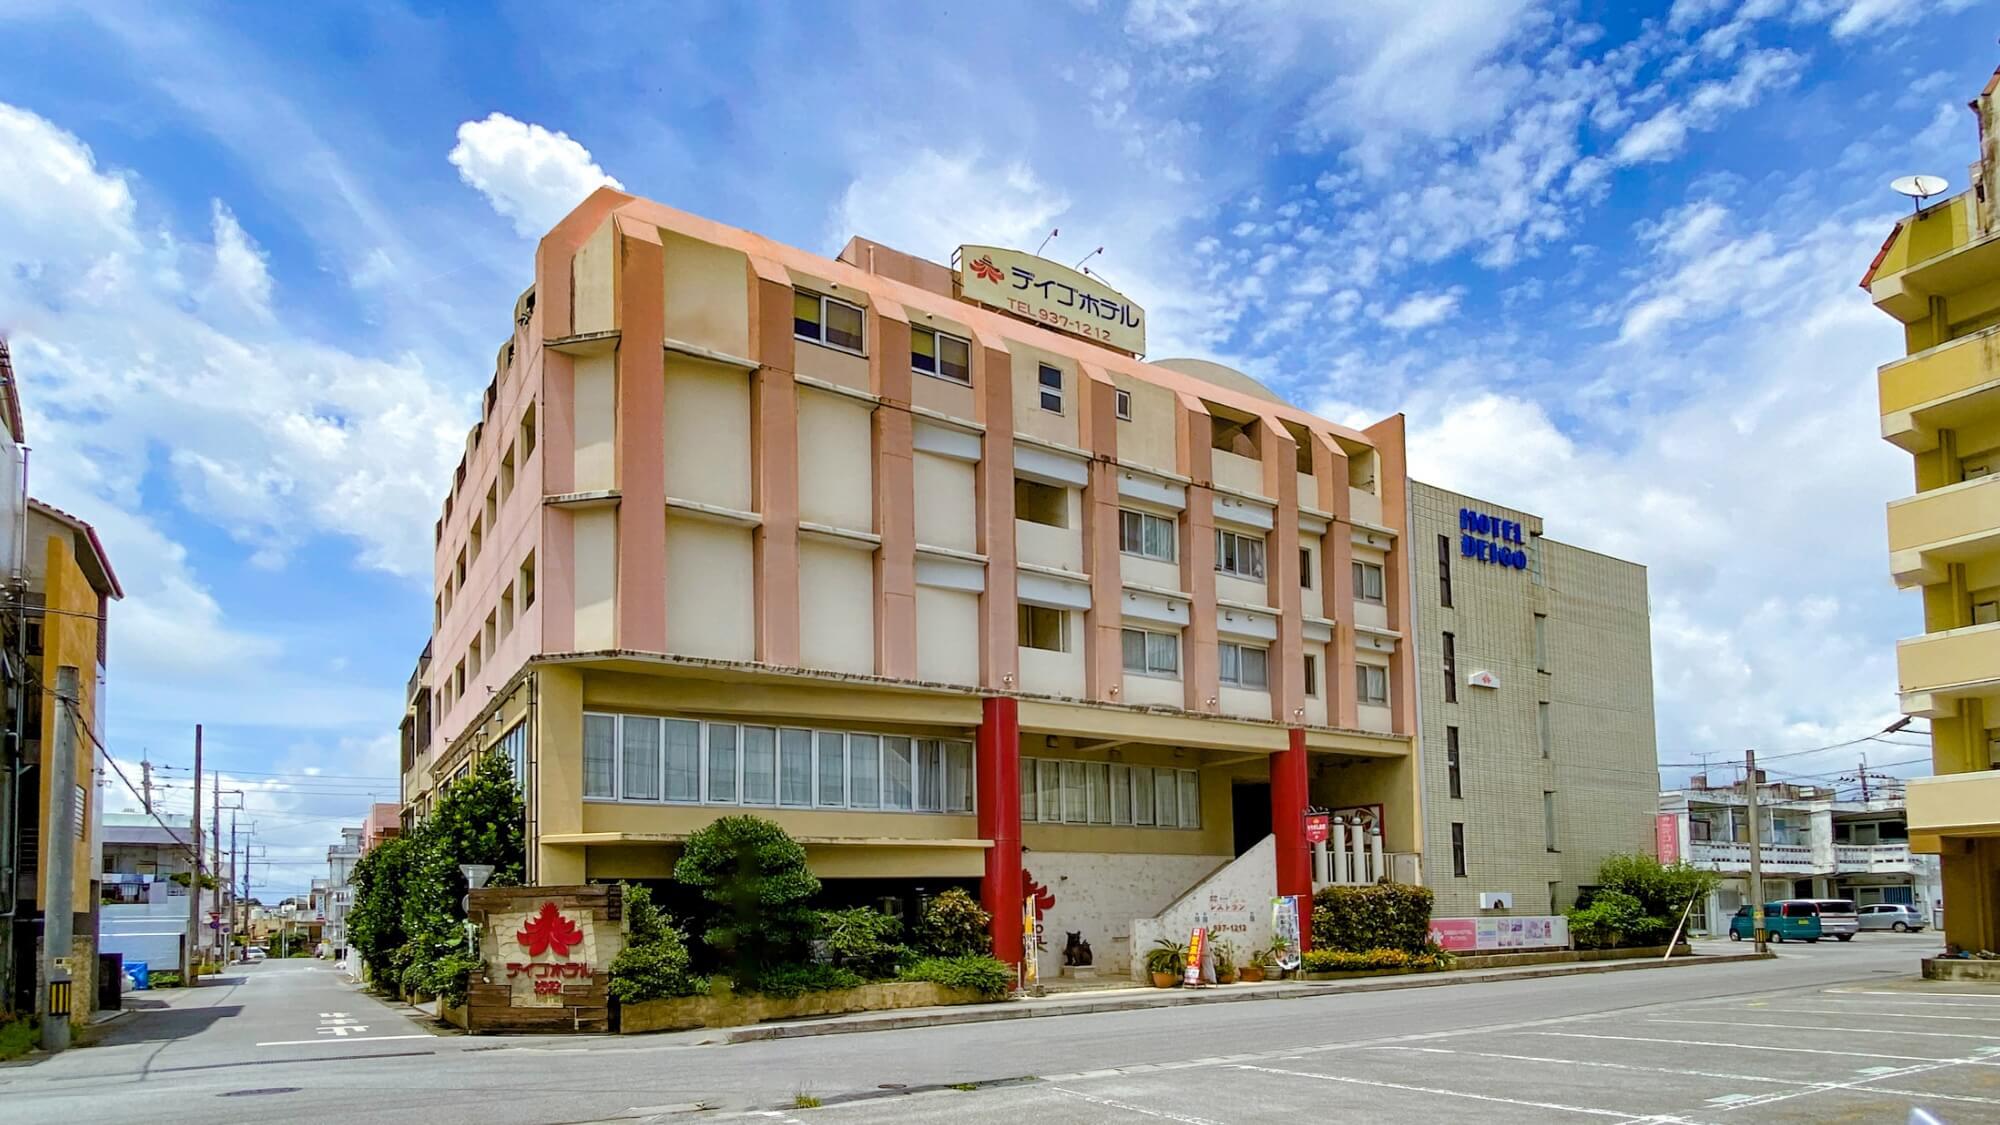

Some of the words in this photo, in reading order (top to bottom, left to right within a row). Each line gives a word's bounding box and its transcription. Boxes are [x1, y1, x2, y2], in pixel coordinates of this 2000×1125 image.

[1011, 266, 1140, 328] デイゴホテル
[1459, 508, 1525, 545] HOTEL
[1460, 534, 1527, 570] DEIGO
